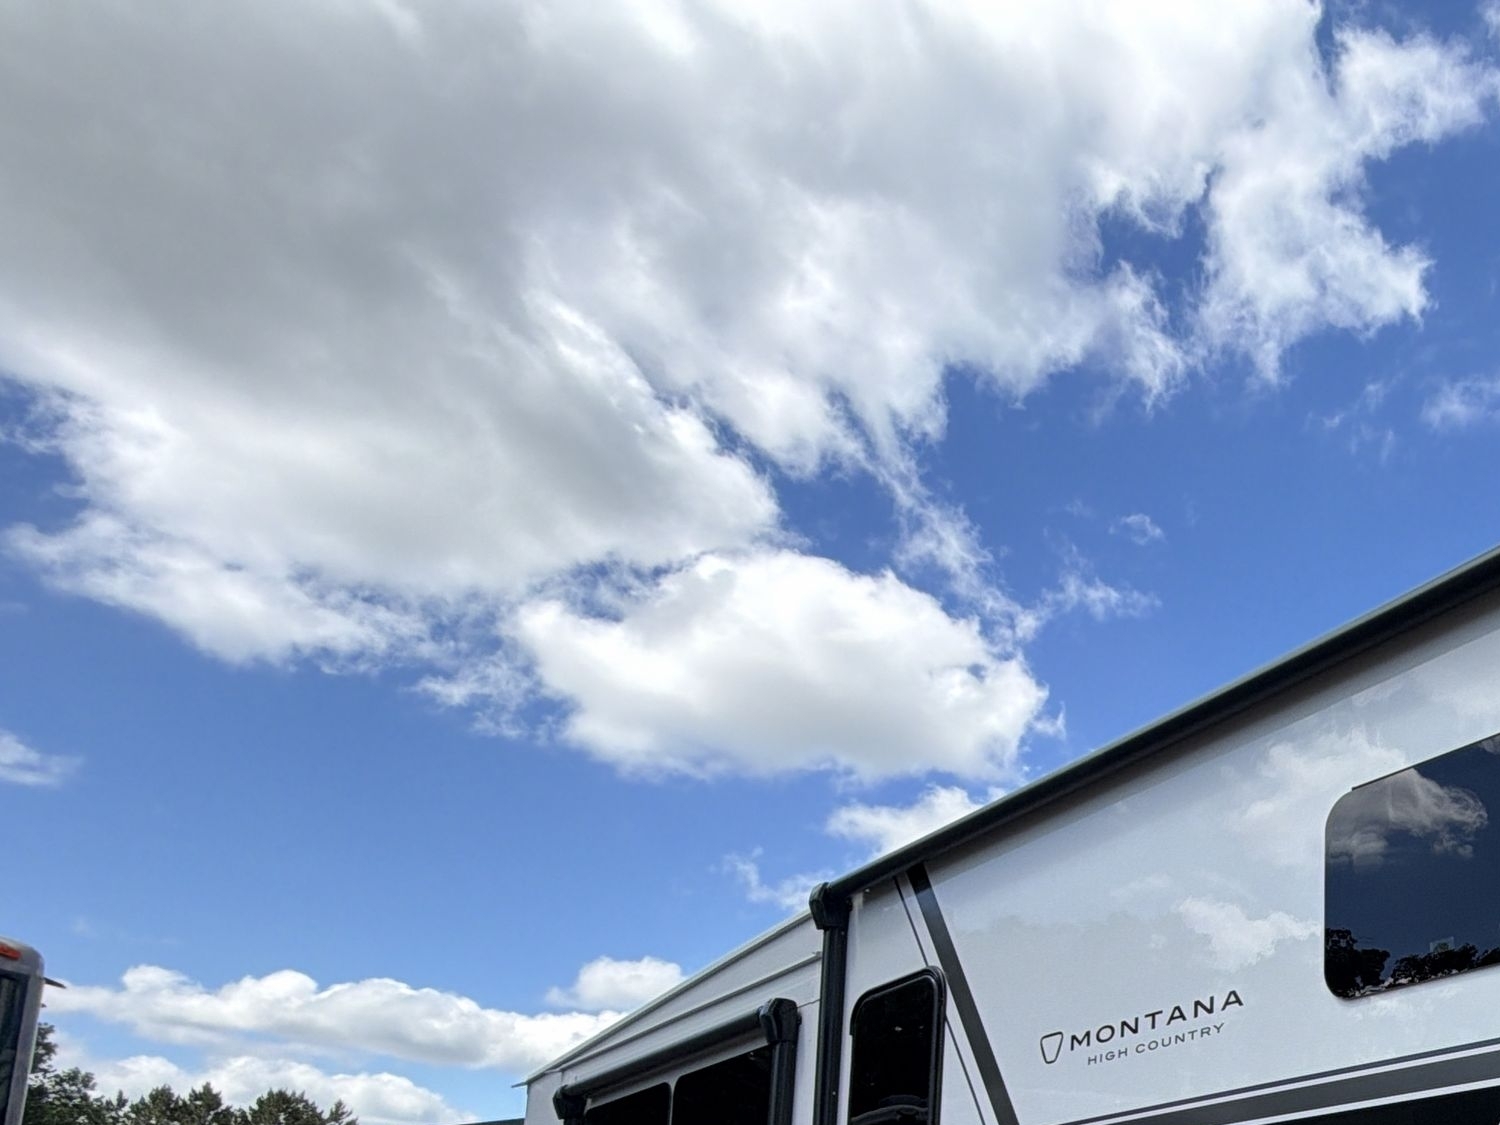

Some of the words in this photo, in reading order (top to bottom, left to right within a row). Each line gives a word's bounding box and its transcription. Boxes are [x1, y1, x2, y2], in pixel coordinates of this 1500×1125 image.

[1070, 990, 1244, 1051] MONTANA
[1087, 1047, 1129, 1066] HIGH
[1135, 1022, 1225, 1054] COUNTRY
